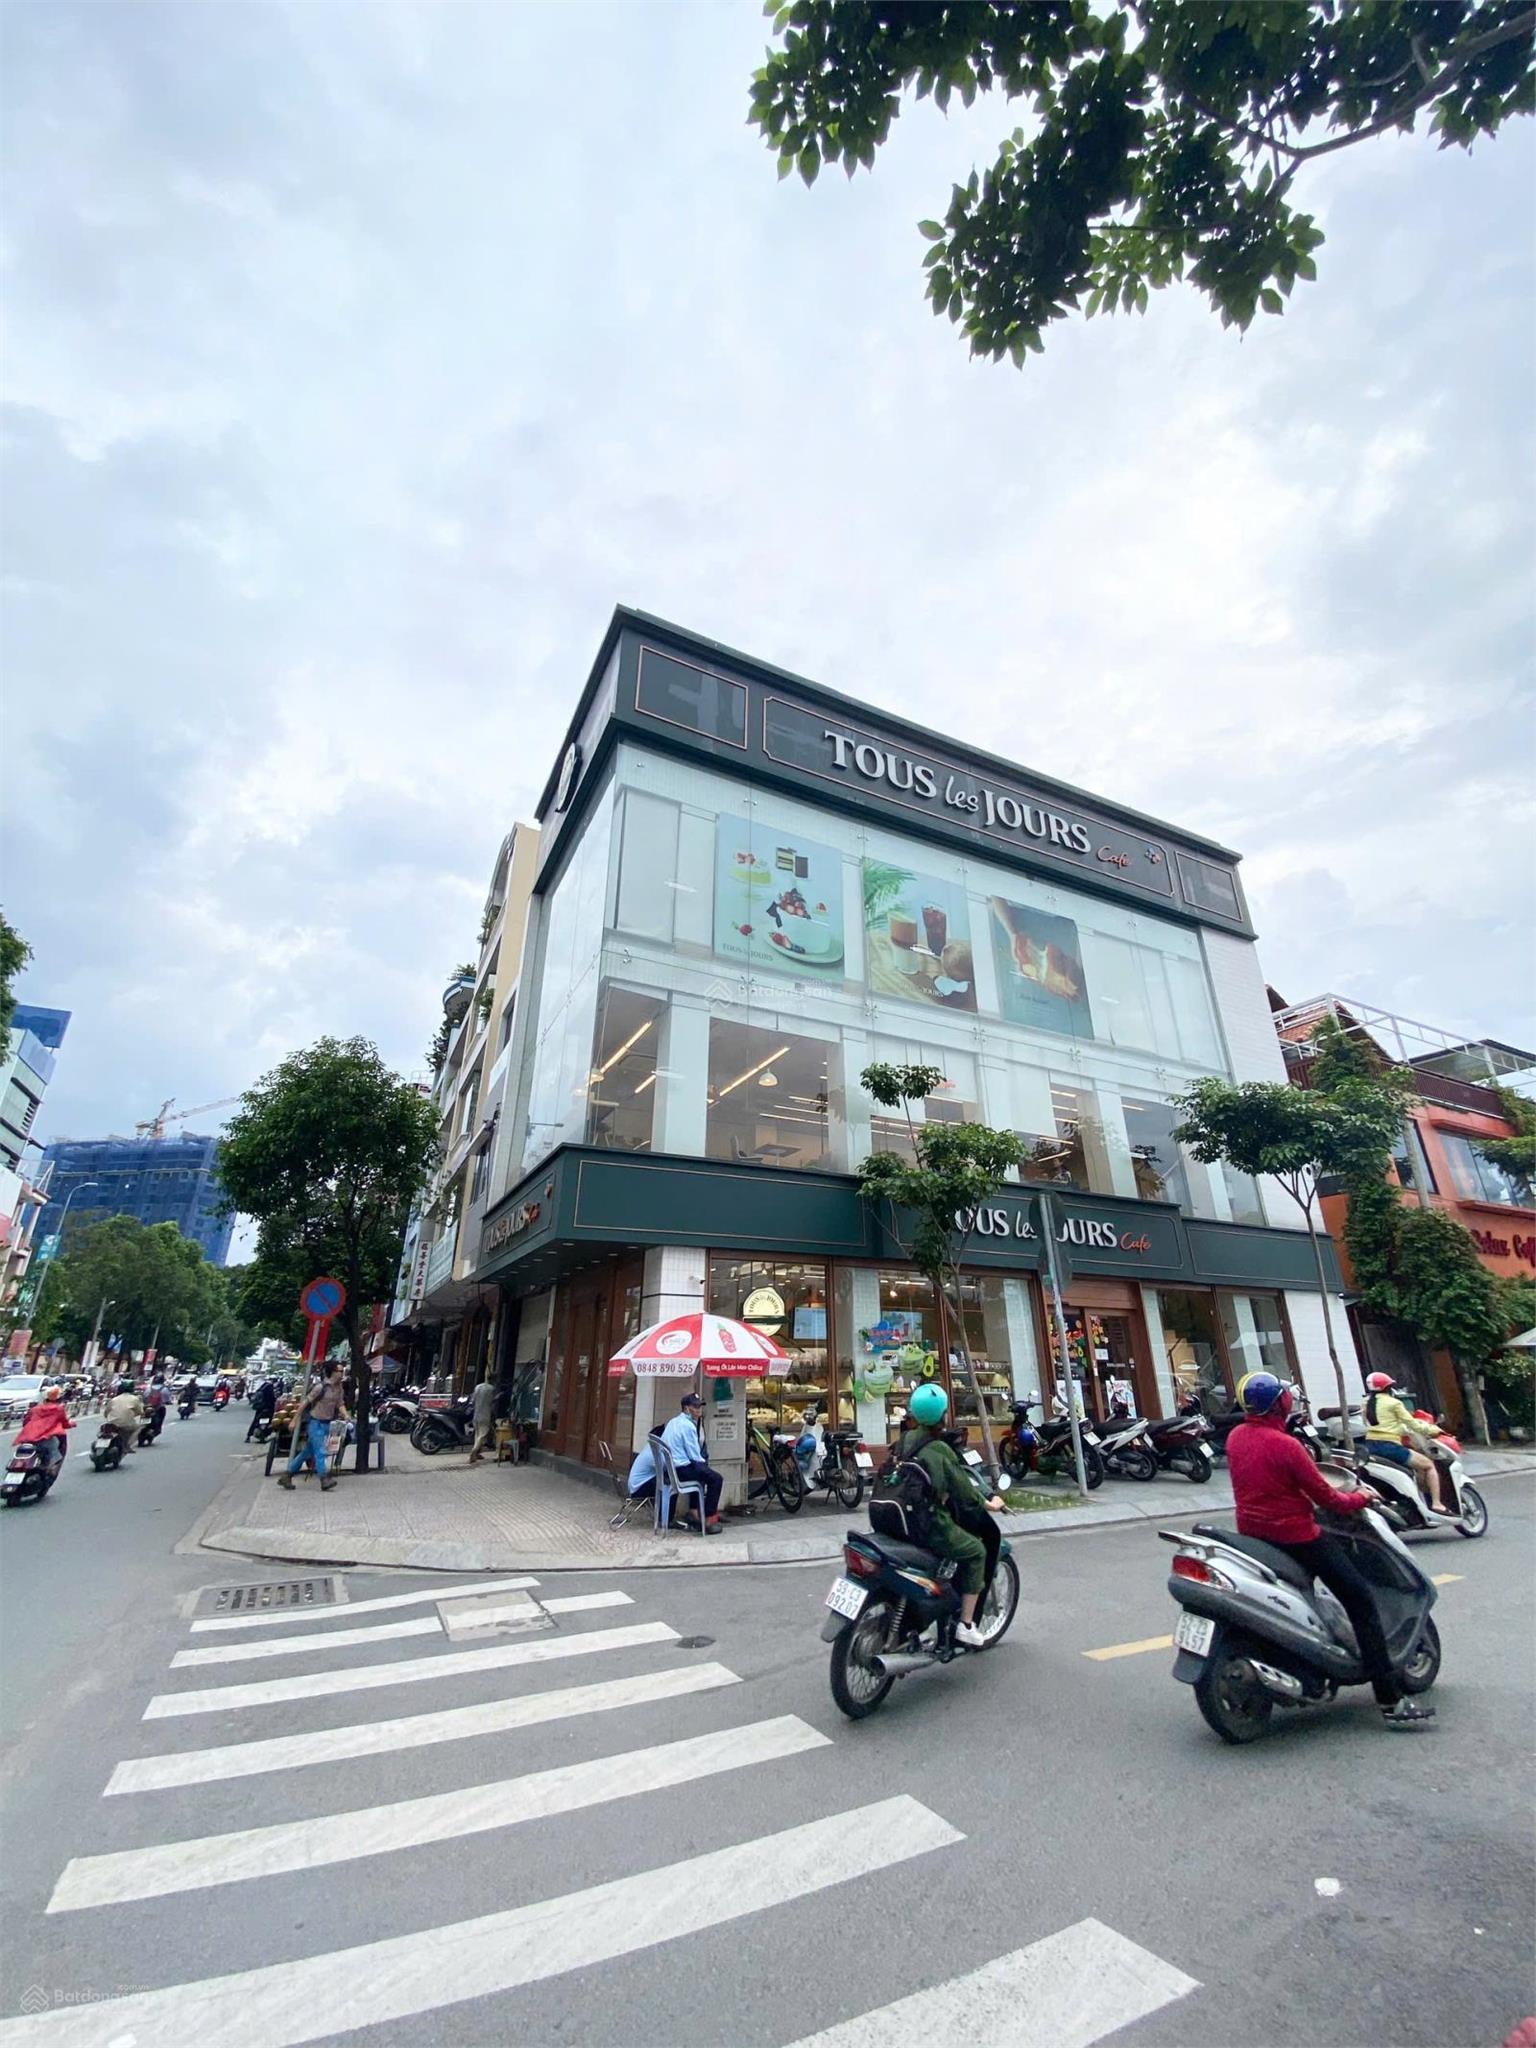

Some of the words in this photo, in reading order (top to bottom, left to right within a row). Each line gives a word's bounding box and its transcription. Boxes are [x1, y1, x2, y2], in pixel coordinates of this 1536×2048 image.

[824, 729, 938, 799] TOUS
[945, 775, 979, 813] les
[980, 789, 1092, 854] JOURS
[945, 1206, 1009, 1237] OUS
[1056, 1217, 1117, 1248] URS
[678, 1363, 693, 1374] 525
